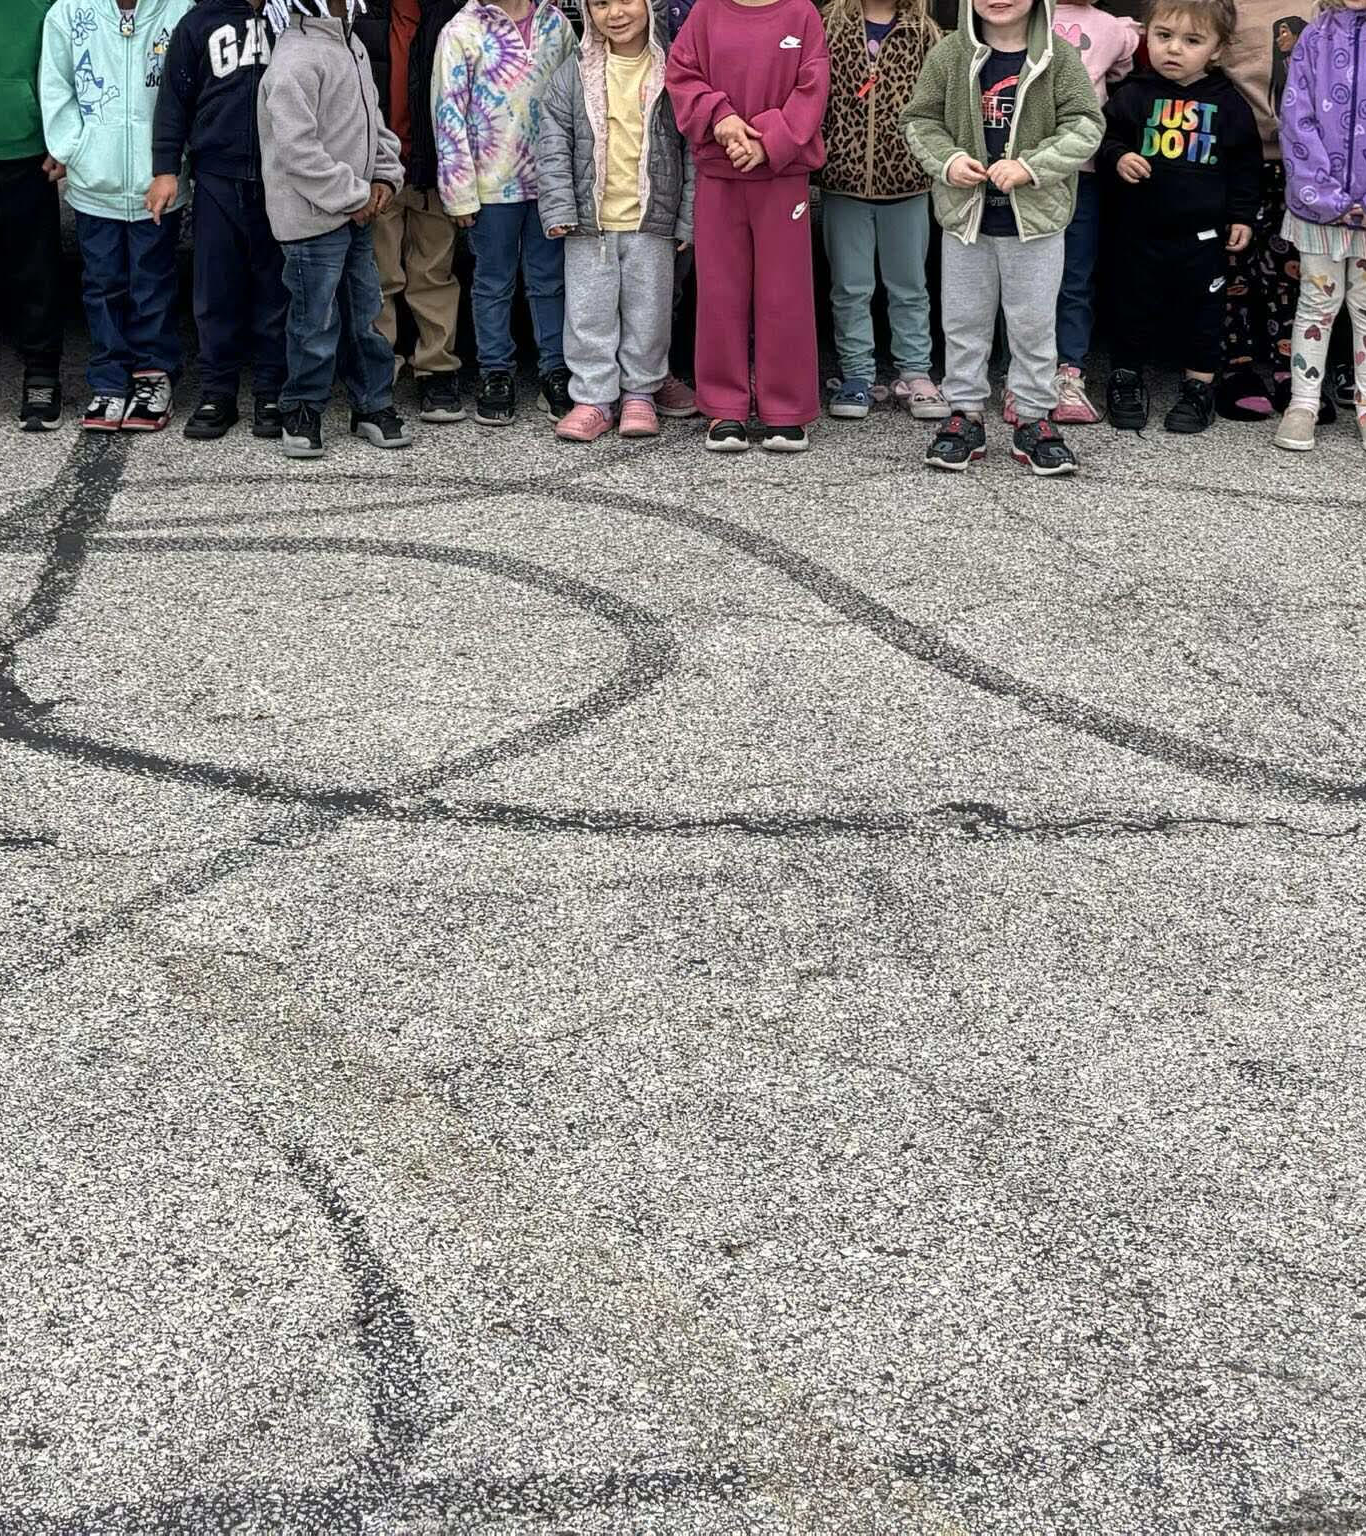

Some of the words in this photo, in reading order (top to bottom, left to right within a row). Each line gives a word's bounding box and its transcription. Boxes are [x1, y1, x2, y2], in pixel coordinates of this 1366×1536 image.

[208, 18, 272, 79] GA
[1146, 98, 1218, 133] JUST
[1140, 127, 1184, 160] DO
[1186, 131, 1218, 164] IT.
